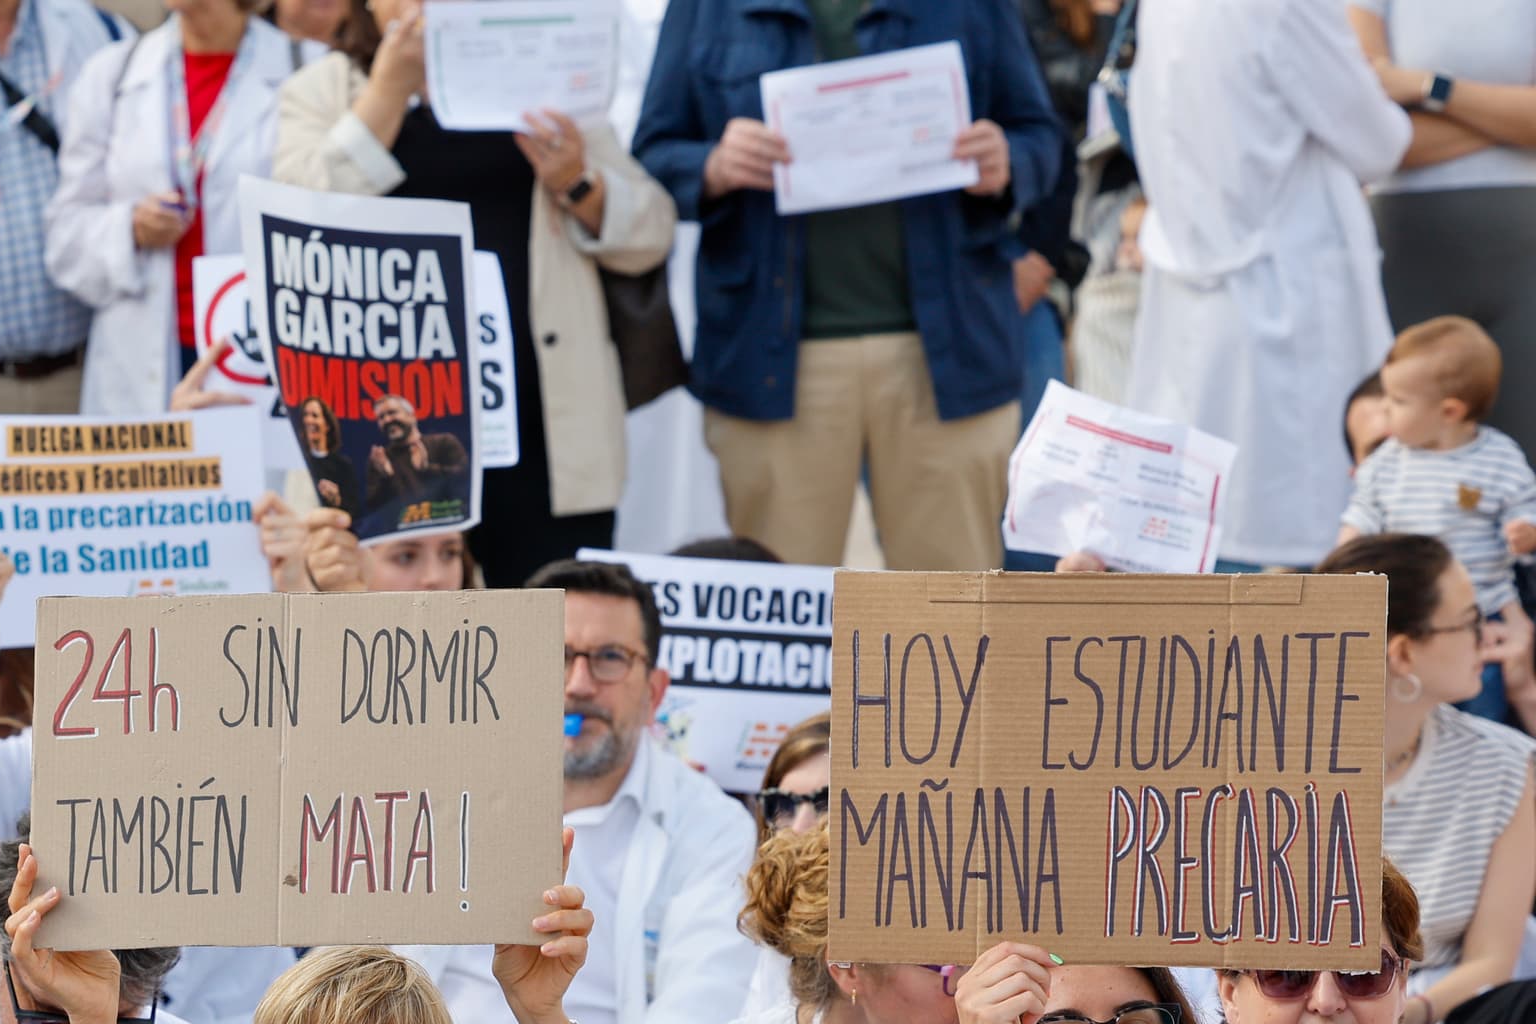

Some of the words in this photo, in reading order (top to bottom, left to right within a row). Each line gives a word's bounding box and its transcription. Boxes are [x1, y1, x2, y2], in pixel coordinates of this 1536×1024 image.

[271, 230, 448, 303] MÓNICA
[274, 288, 457, 360] GARCÍA
[13, 426, 83, 452] HUELGA
[92, 421, 188, 451] NACIONAL
[76, 469, 85, 493] y
[93, 459, 222, 490] Facultativos
[14, 503, 39, 531] la
[49, 496, 253, 533] precarización
[41, 546, 69, 574] la
[78, 540, 210, 573] Sanidad
[693, 584, 833, 627] VOCACI
[53, 626, 181, 740] 24h
[219, 616, 302, 728] SIN
[340, 617, 501, 726] DORMIR
[851, 630, 990, 769] HOY
[1041, 629, 1370, 774] ESTUDIANTE
[57, 777, 248, 897] TAMBIÉN
[299, 789, 436, 896] MATA
[839, 778, 1065, 936] MAÑANA
[1103, 781, 1367, 948] PRECARIA
